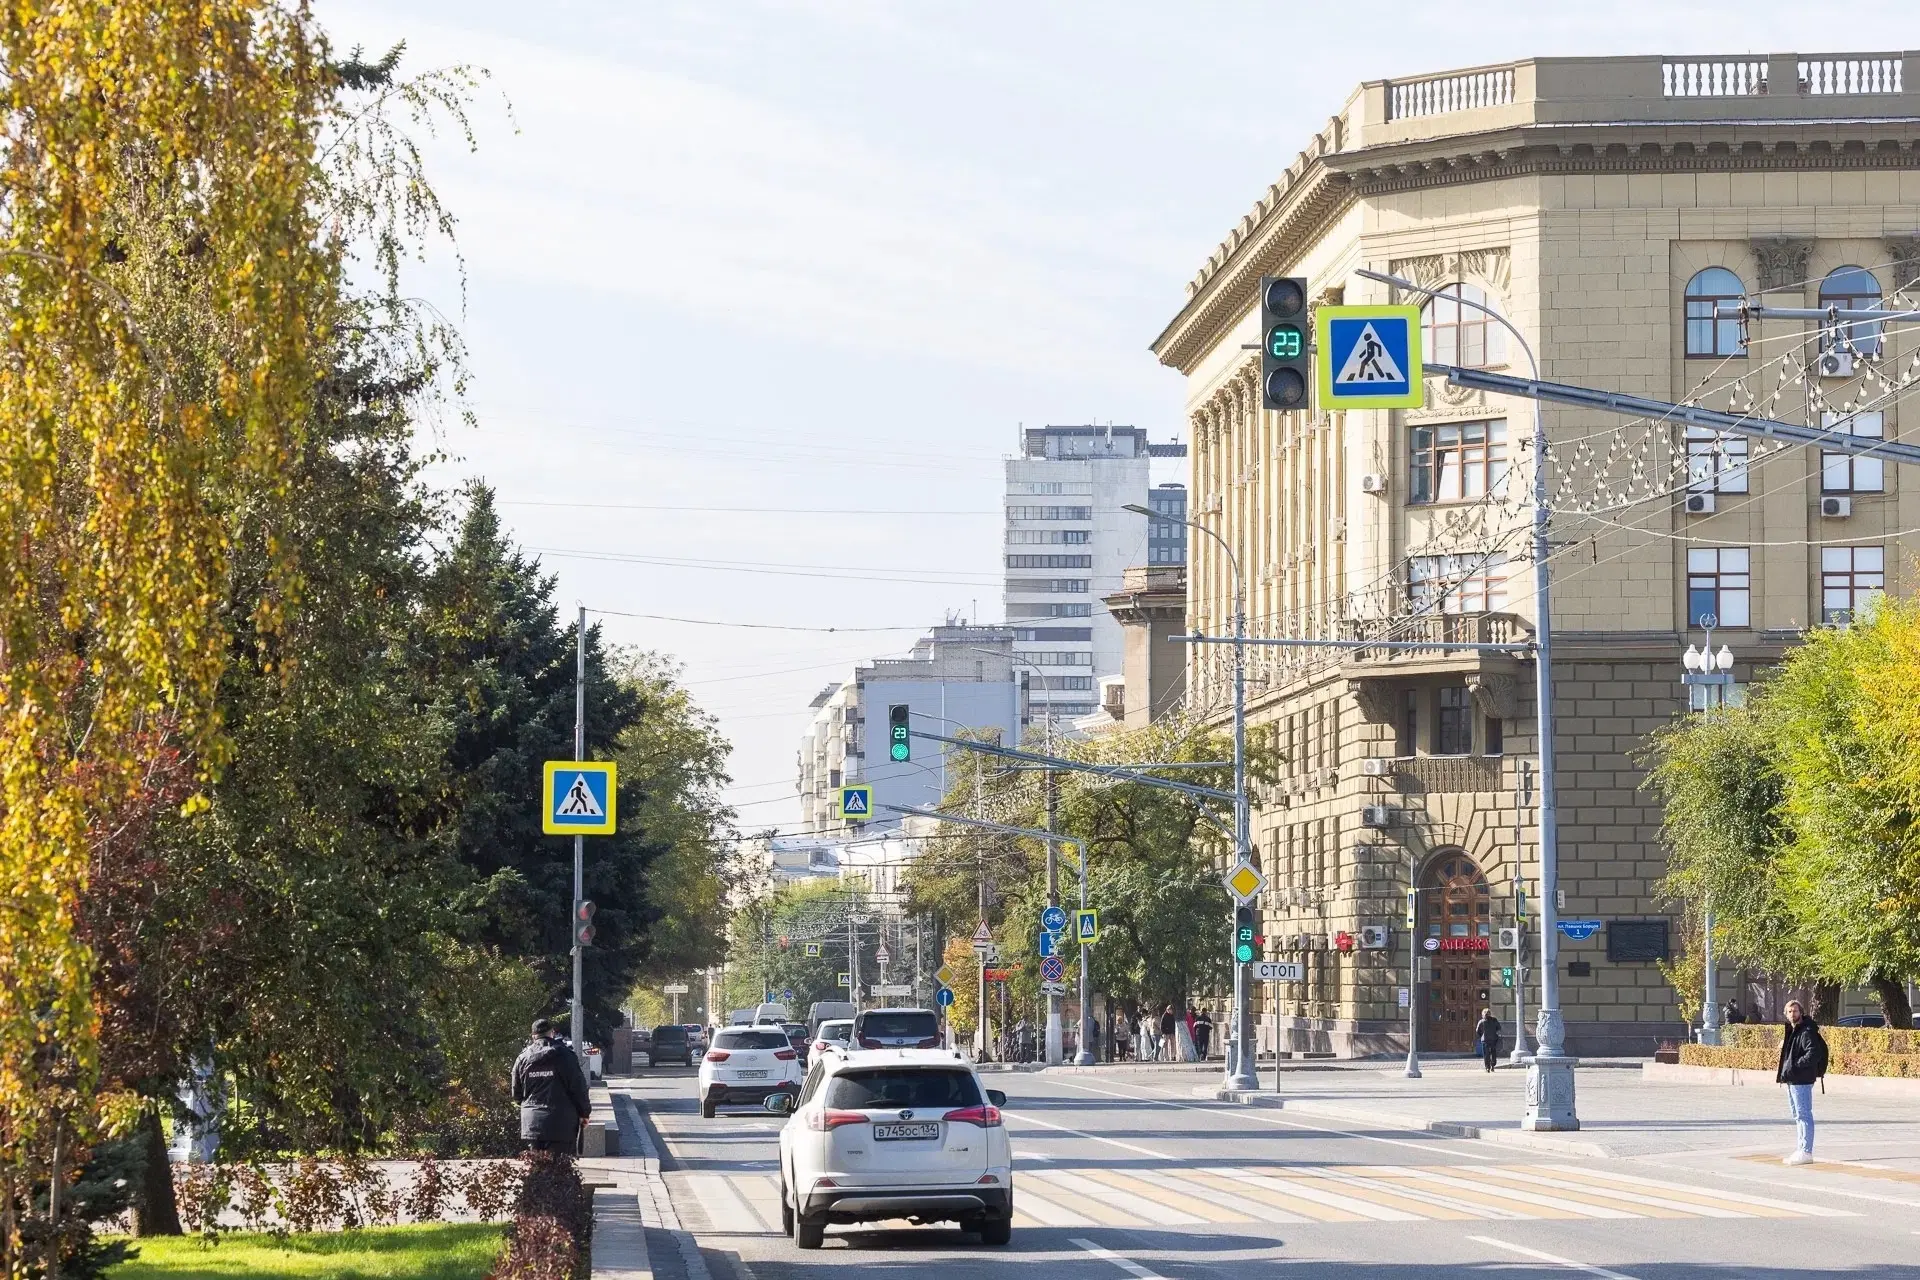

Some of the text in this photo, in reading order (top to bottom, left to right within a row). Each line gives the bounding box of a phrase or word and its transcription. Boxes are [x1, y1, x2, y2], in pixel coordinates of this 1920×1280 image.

[1273, 332, 1299, 356] 23
[894, 727, 907, 739] 23
[1240, 929, 1252, 941] 23
[1440, 938, 1490, 950] АПТЕКА
[1260, 964, 1296, 978] СТОП
[528, 1070, 554, 1078] ПОЛИЦИЯ
[920, 1124, 937, 1133] 134
